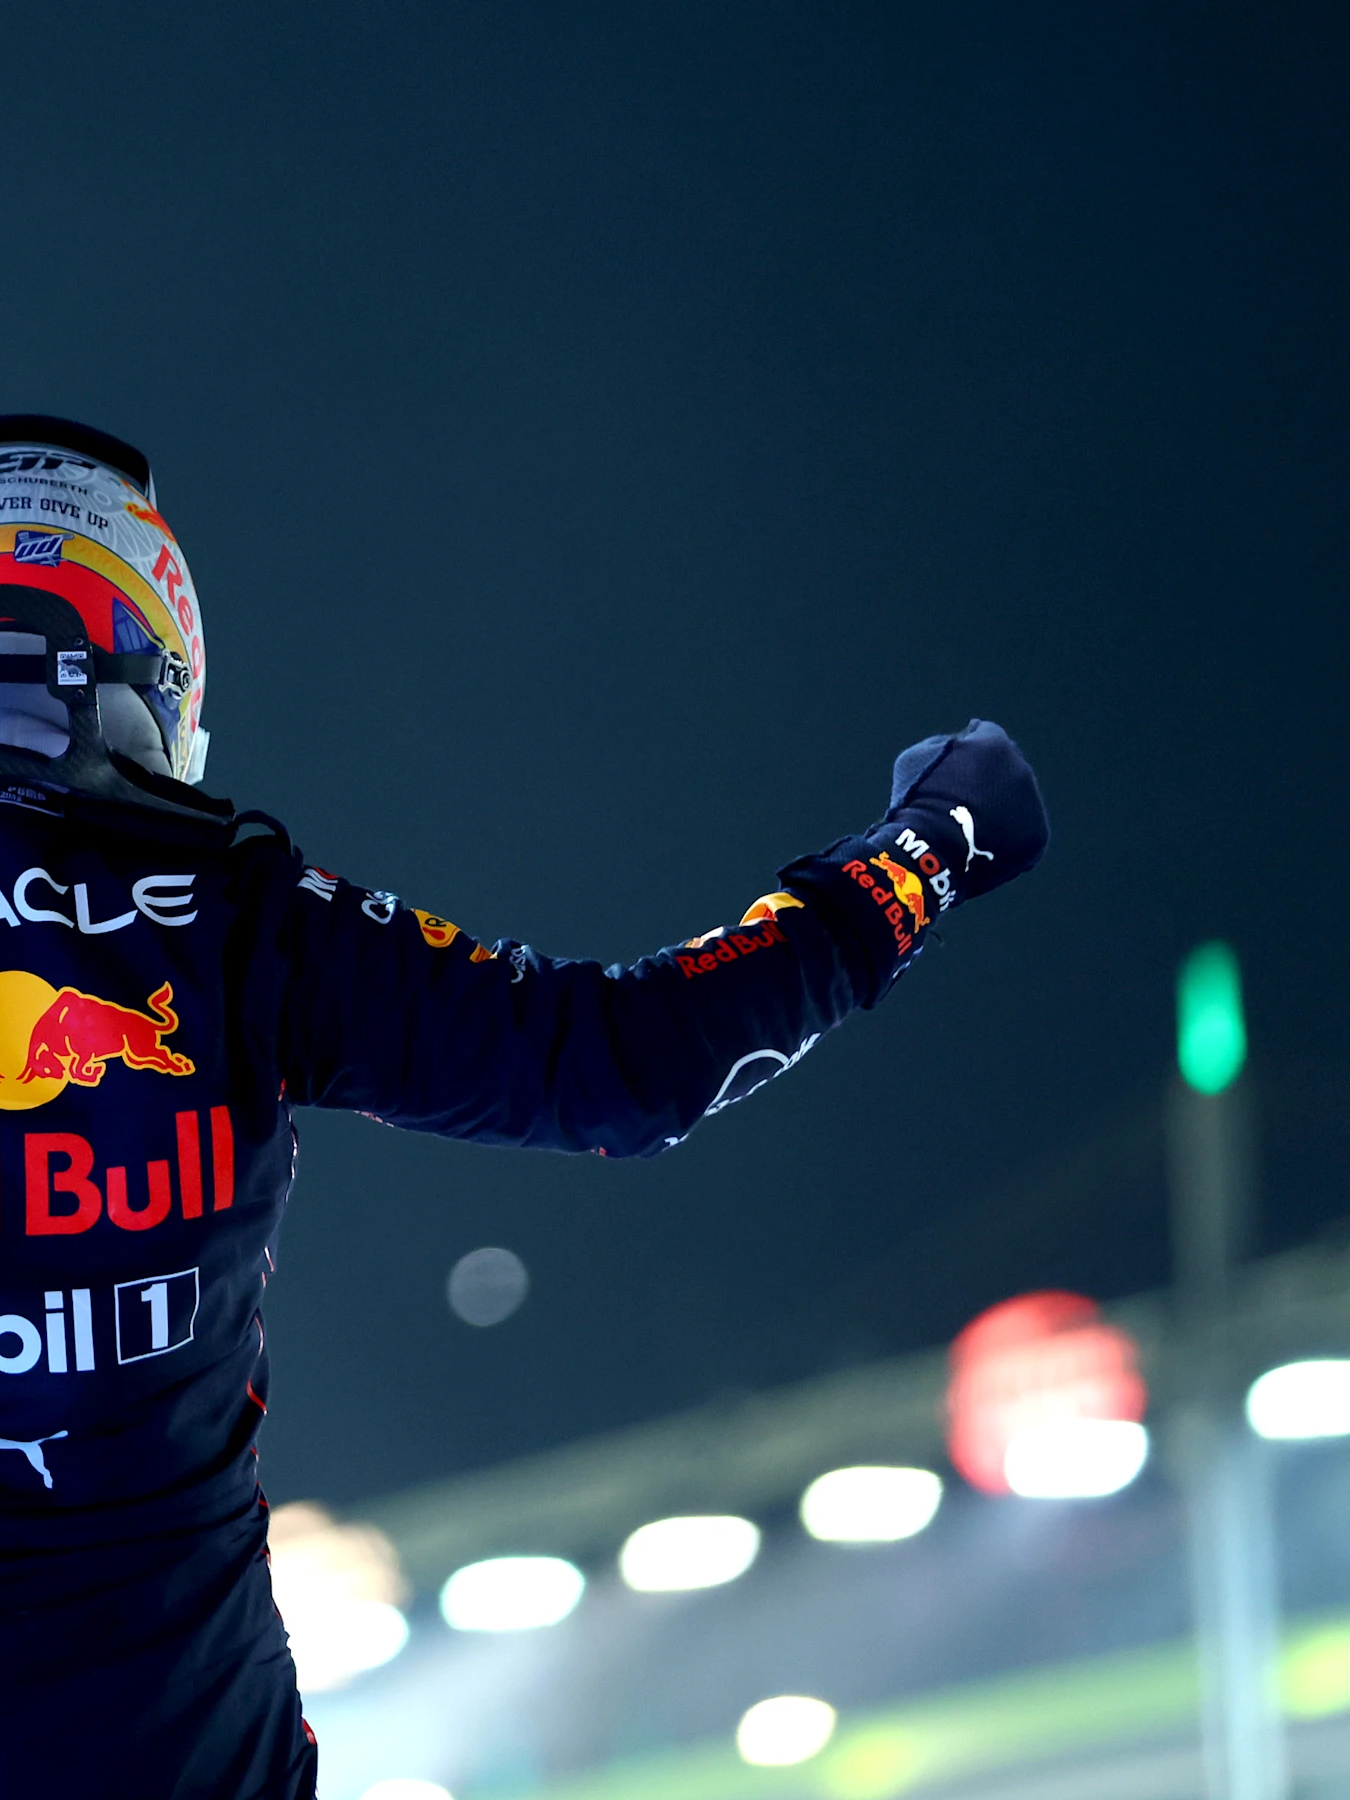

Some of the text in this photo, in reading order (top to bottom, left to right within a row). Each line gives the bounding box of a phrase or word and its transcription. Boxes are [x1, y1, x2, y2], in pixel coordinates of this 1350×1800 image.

[39, 498, 81, 519] GIVE
[87, 510, 109, 530] UP
[894, 827, 957, 912] Mobil
[841, 859, 913, 957] Red Bull
[675, 920, 790, 979] Red Bull
[23, 1105, 235, 1237] Bull
[140, 1282, 174, 1350] 1
